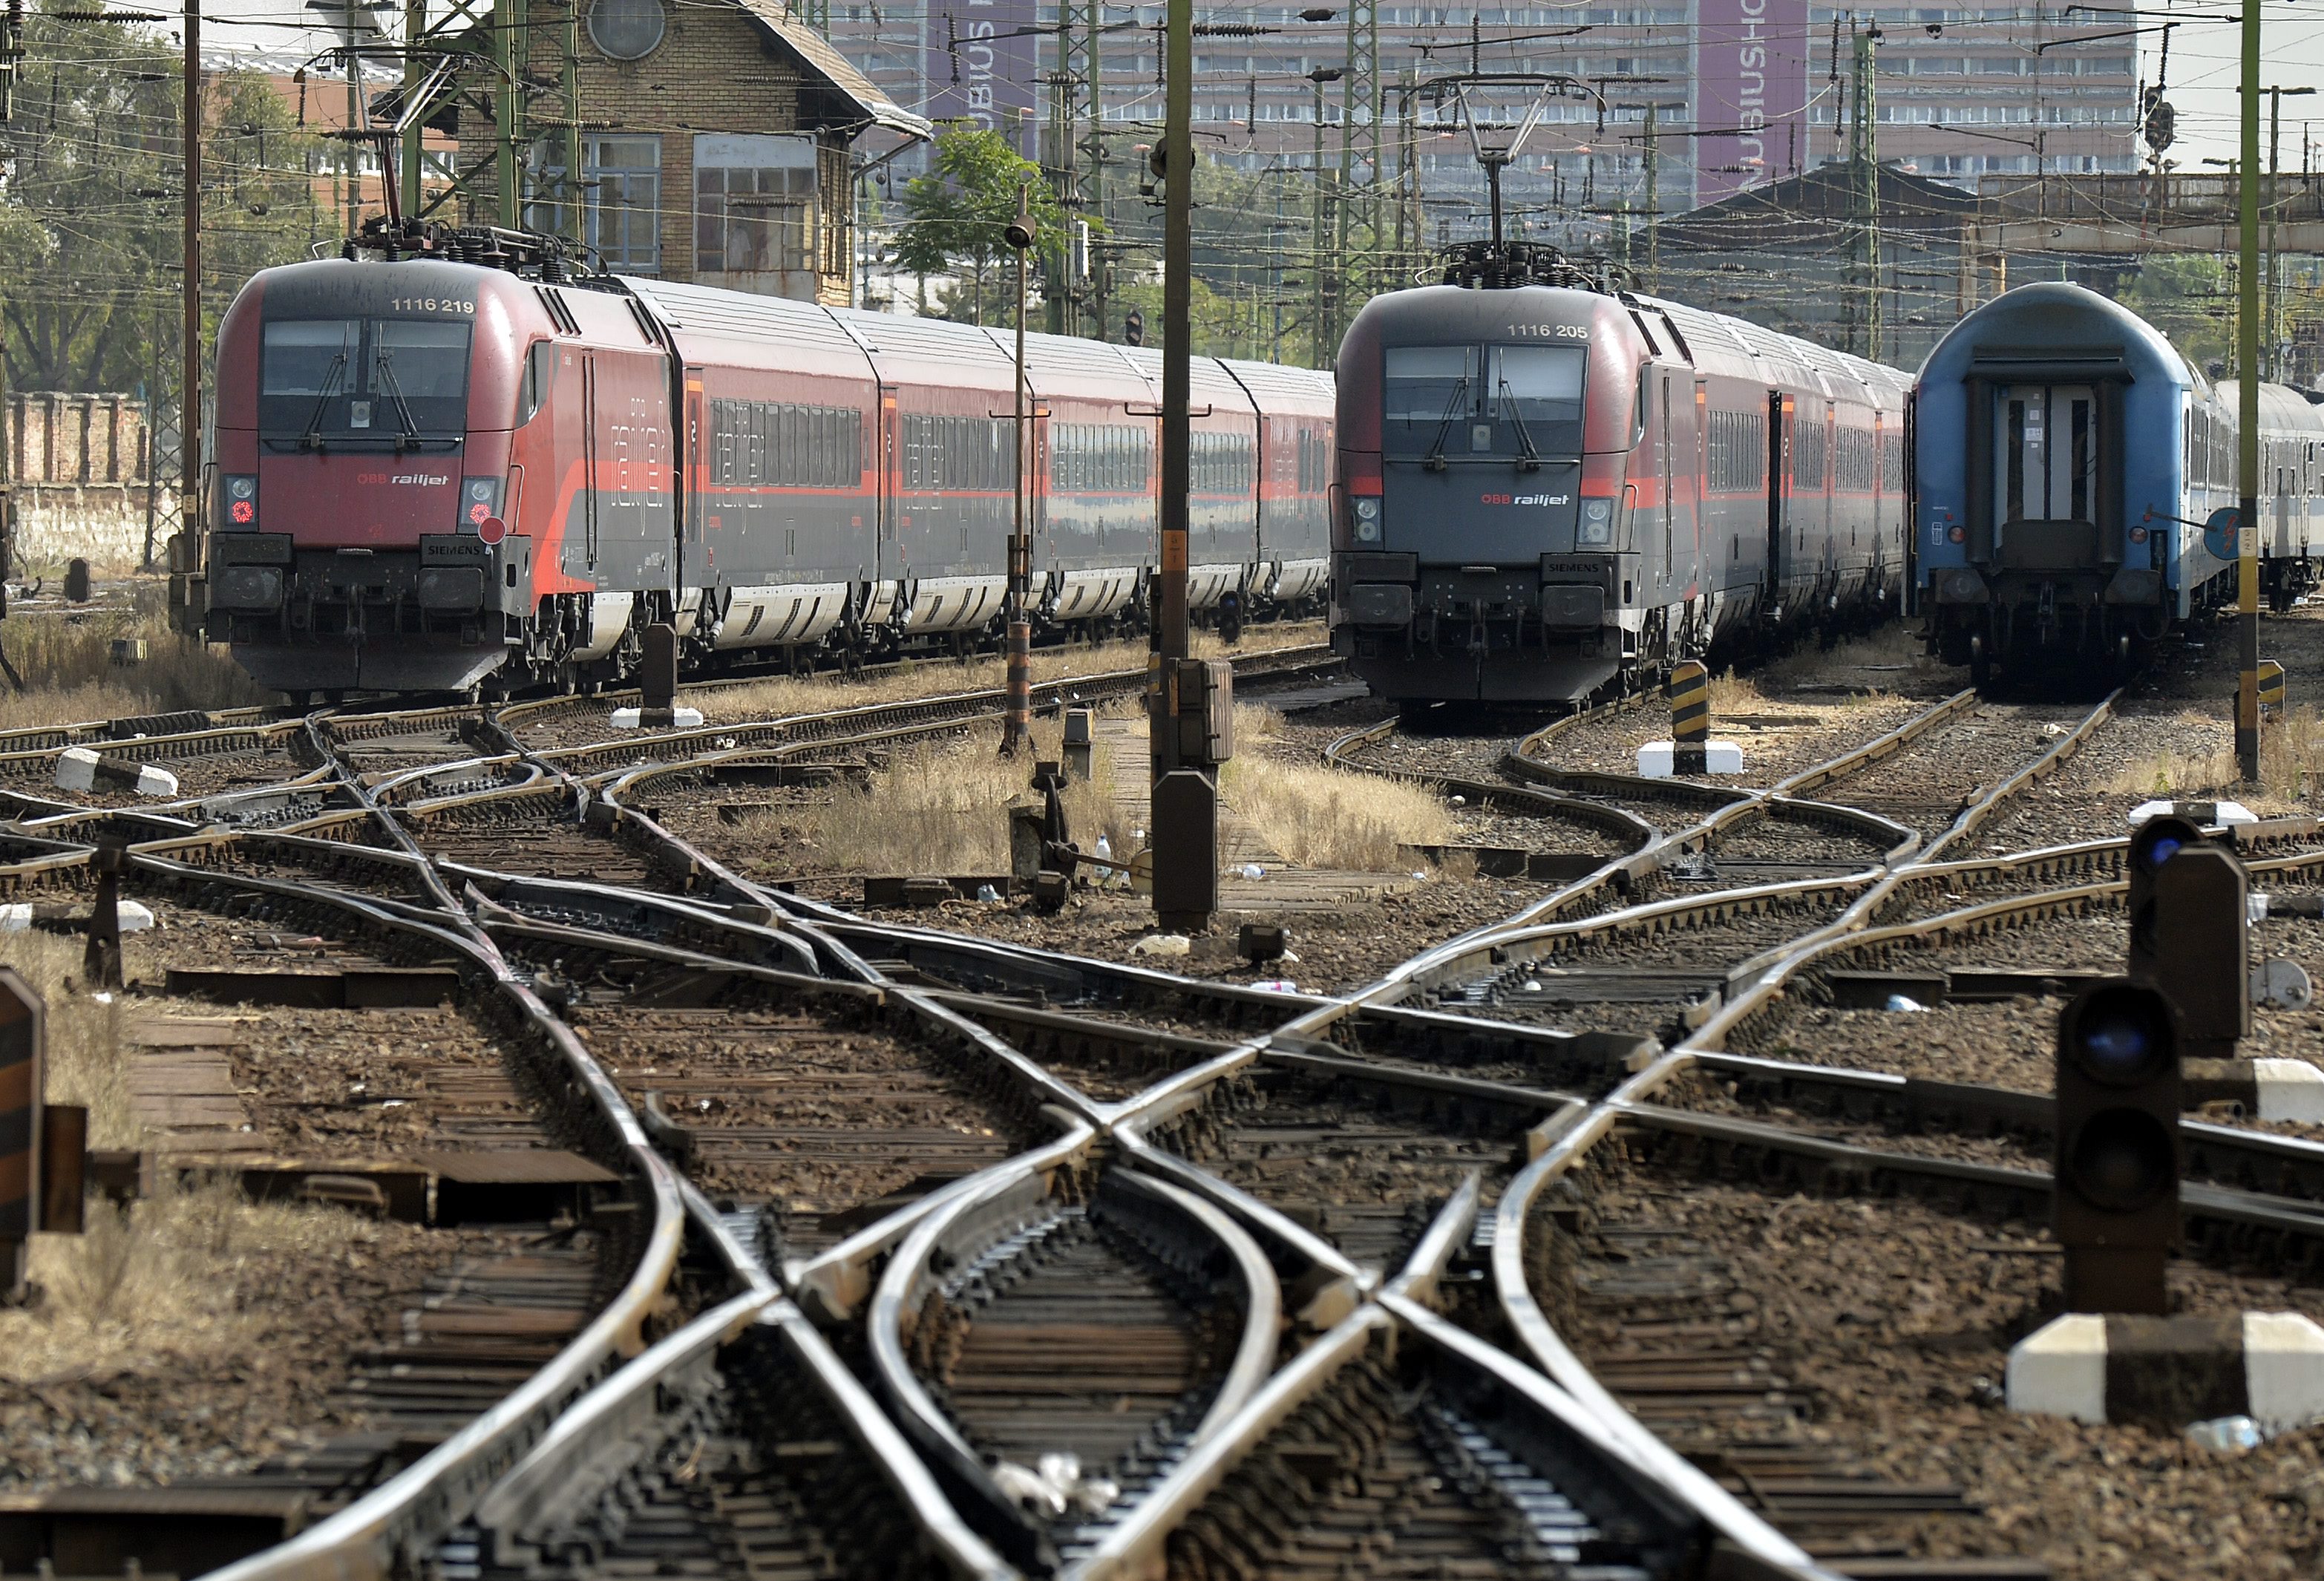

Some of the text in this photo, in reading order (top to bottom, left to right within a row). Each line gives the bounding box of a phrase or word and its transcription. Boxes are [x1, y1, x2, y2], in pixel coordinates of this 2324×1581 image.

[391, 298, 474, 314] 1116 219
[1508, 324, 1588, 338] 1116 205
[392, 474, 448, 486] railjet
[1514, 494, 1569, 506] railjet
[428, 546, 480, 555] SIEMENS
[1548, 563, 1599, 572] SIEMENS
